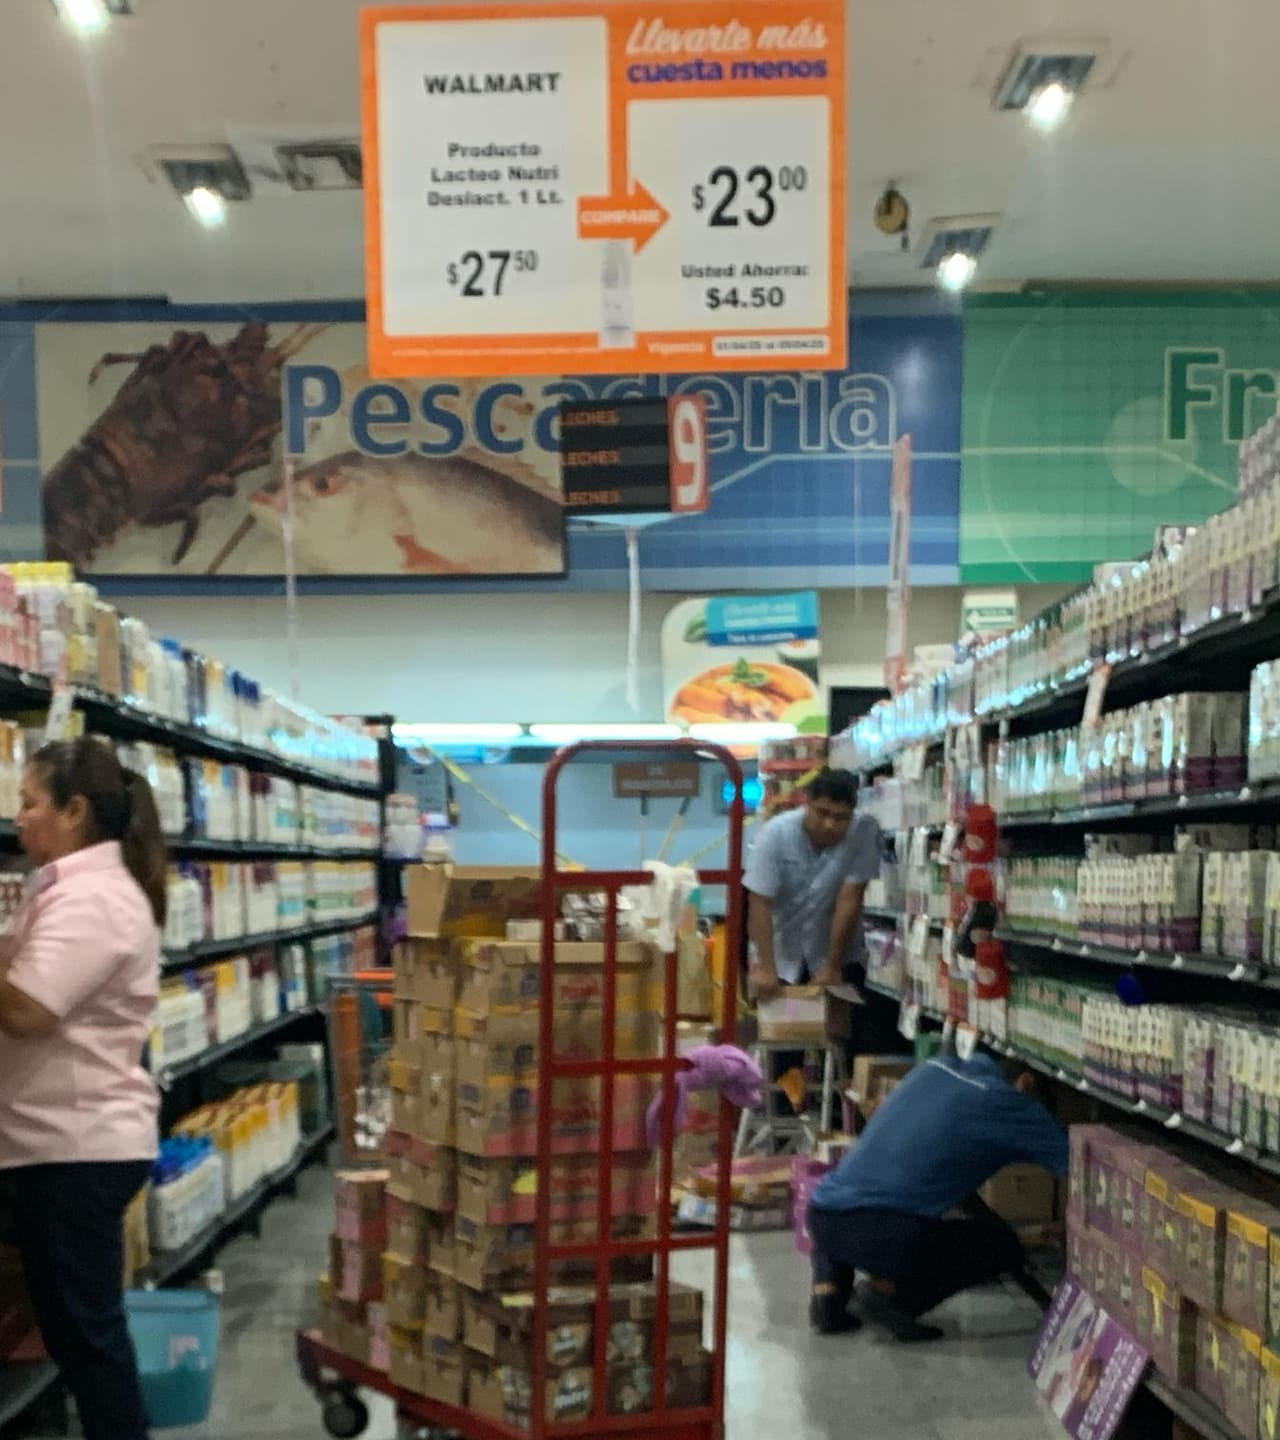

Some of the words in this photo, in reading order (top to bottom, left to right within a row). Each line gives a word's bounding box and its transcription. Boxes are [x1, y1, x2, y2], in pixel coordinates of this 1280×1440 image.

[626, 18, 751, 56] Llevarte
[757, 18, 829, 50] más
[628, 59, 724, 83] cuesta
[731, 58, 828, 80] menos
[423, 72, 562, 95] WALMART
[448, 142, 542, 158] Producto
[431, 167, 501, 183] Lacteo
[508, 165, 559, 181] Nutri
[520, 190, 529, 204] 1
[537, 189, 564, 204] Lt.
[682, 265, 735, 278] Usted
[705, 287, 785, 310] $4.50
[673, 400, 702, 505] 9
